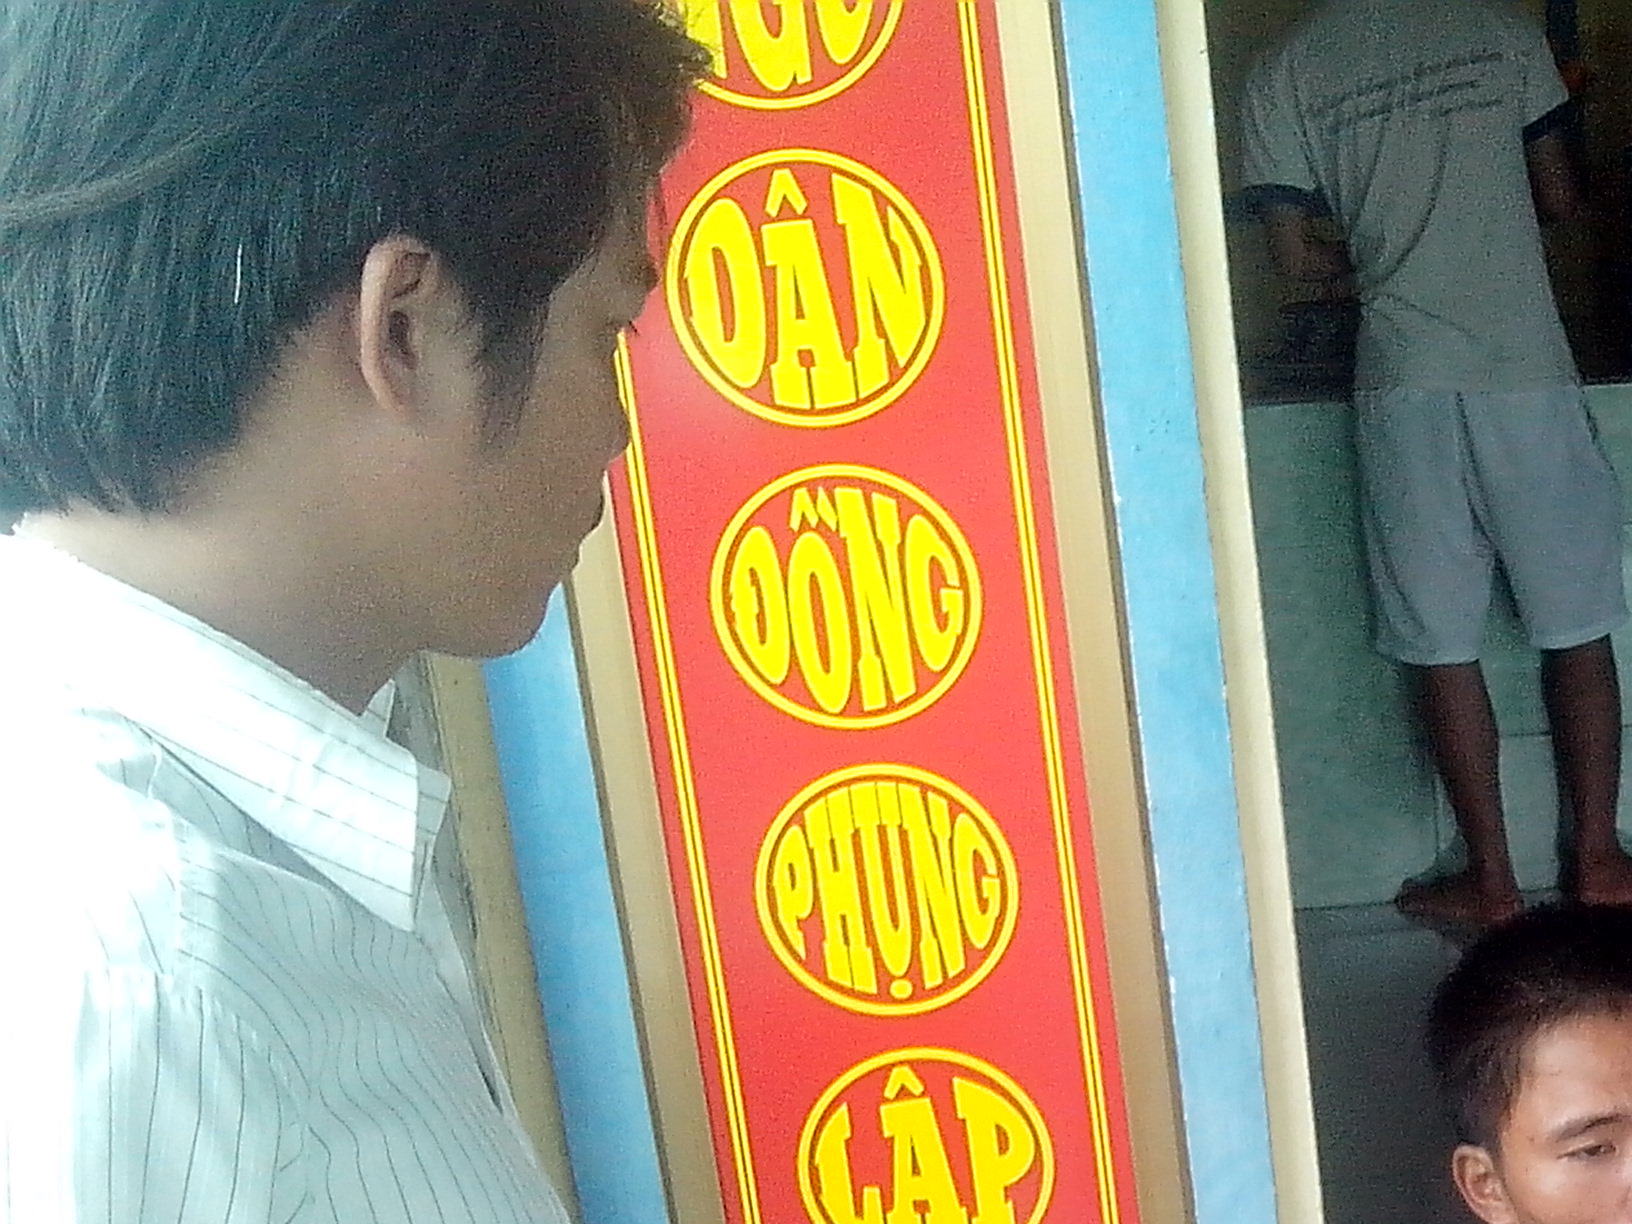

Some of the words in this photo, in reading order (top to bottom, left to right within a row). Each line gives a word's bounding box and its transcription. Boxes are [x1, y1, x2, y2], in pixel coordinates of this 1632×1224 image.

[685, 167, 927, 411] DÂN
[729, 486, 965, 715] ĐỒNG
[772, 780, 1001, 1000] PHỤNG
